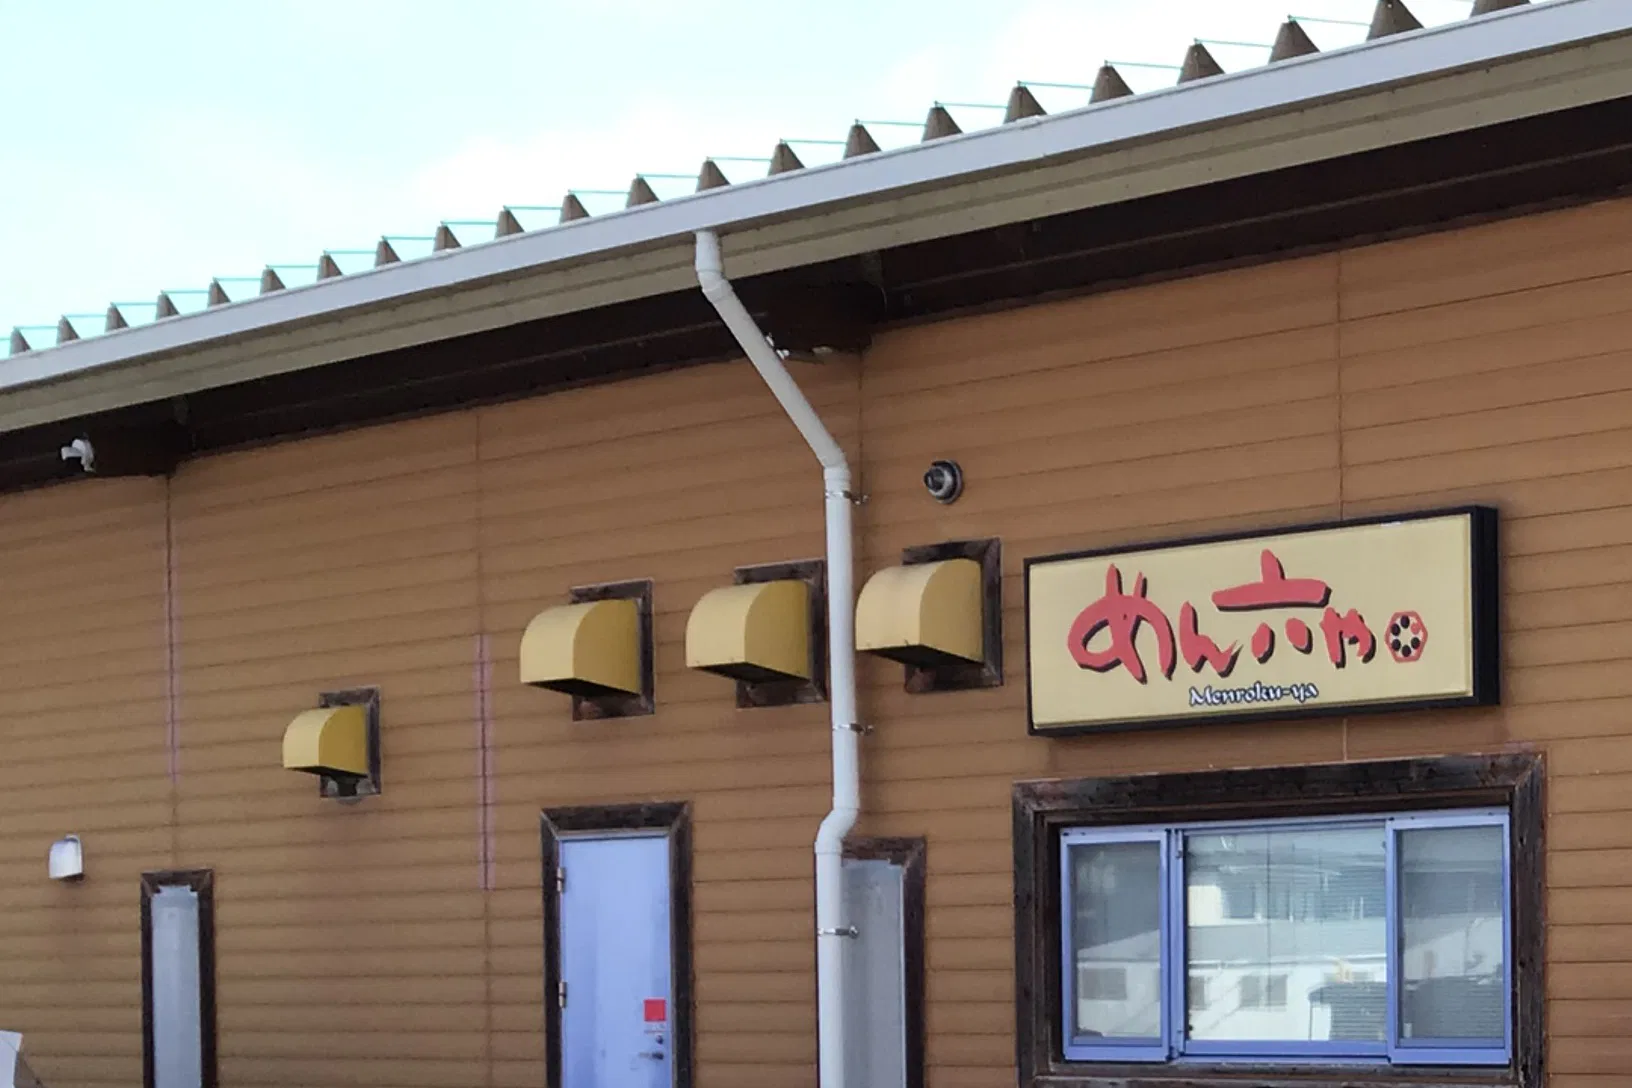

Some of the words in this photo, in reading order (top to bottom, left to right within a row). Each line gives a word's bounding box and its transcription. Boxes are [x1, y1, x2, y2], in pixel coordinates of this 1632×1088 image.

[1067, 548, 1377, 685] めん六や
[1189, 681, 1319, 707] Menroku-ya
